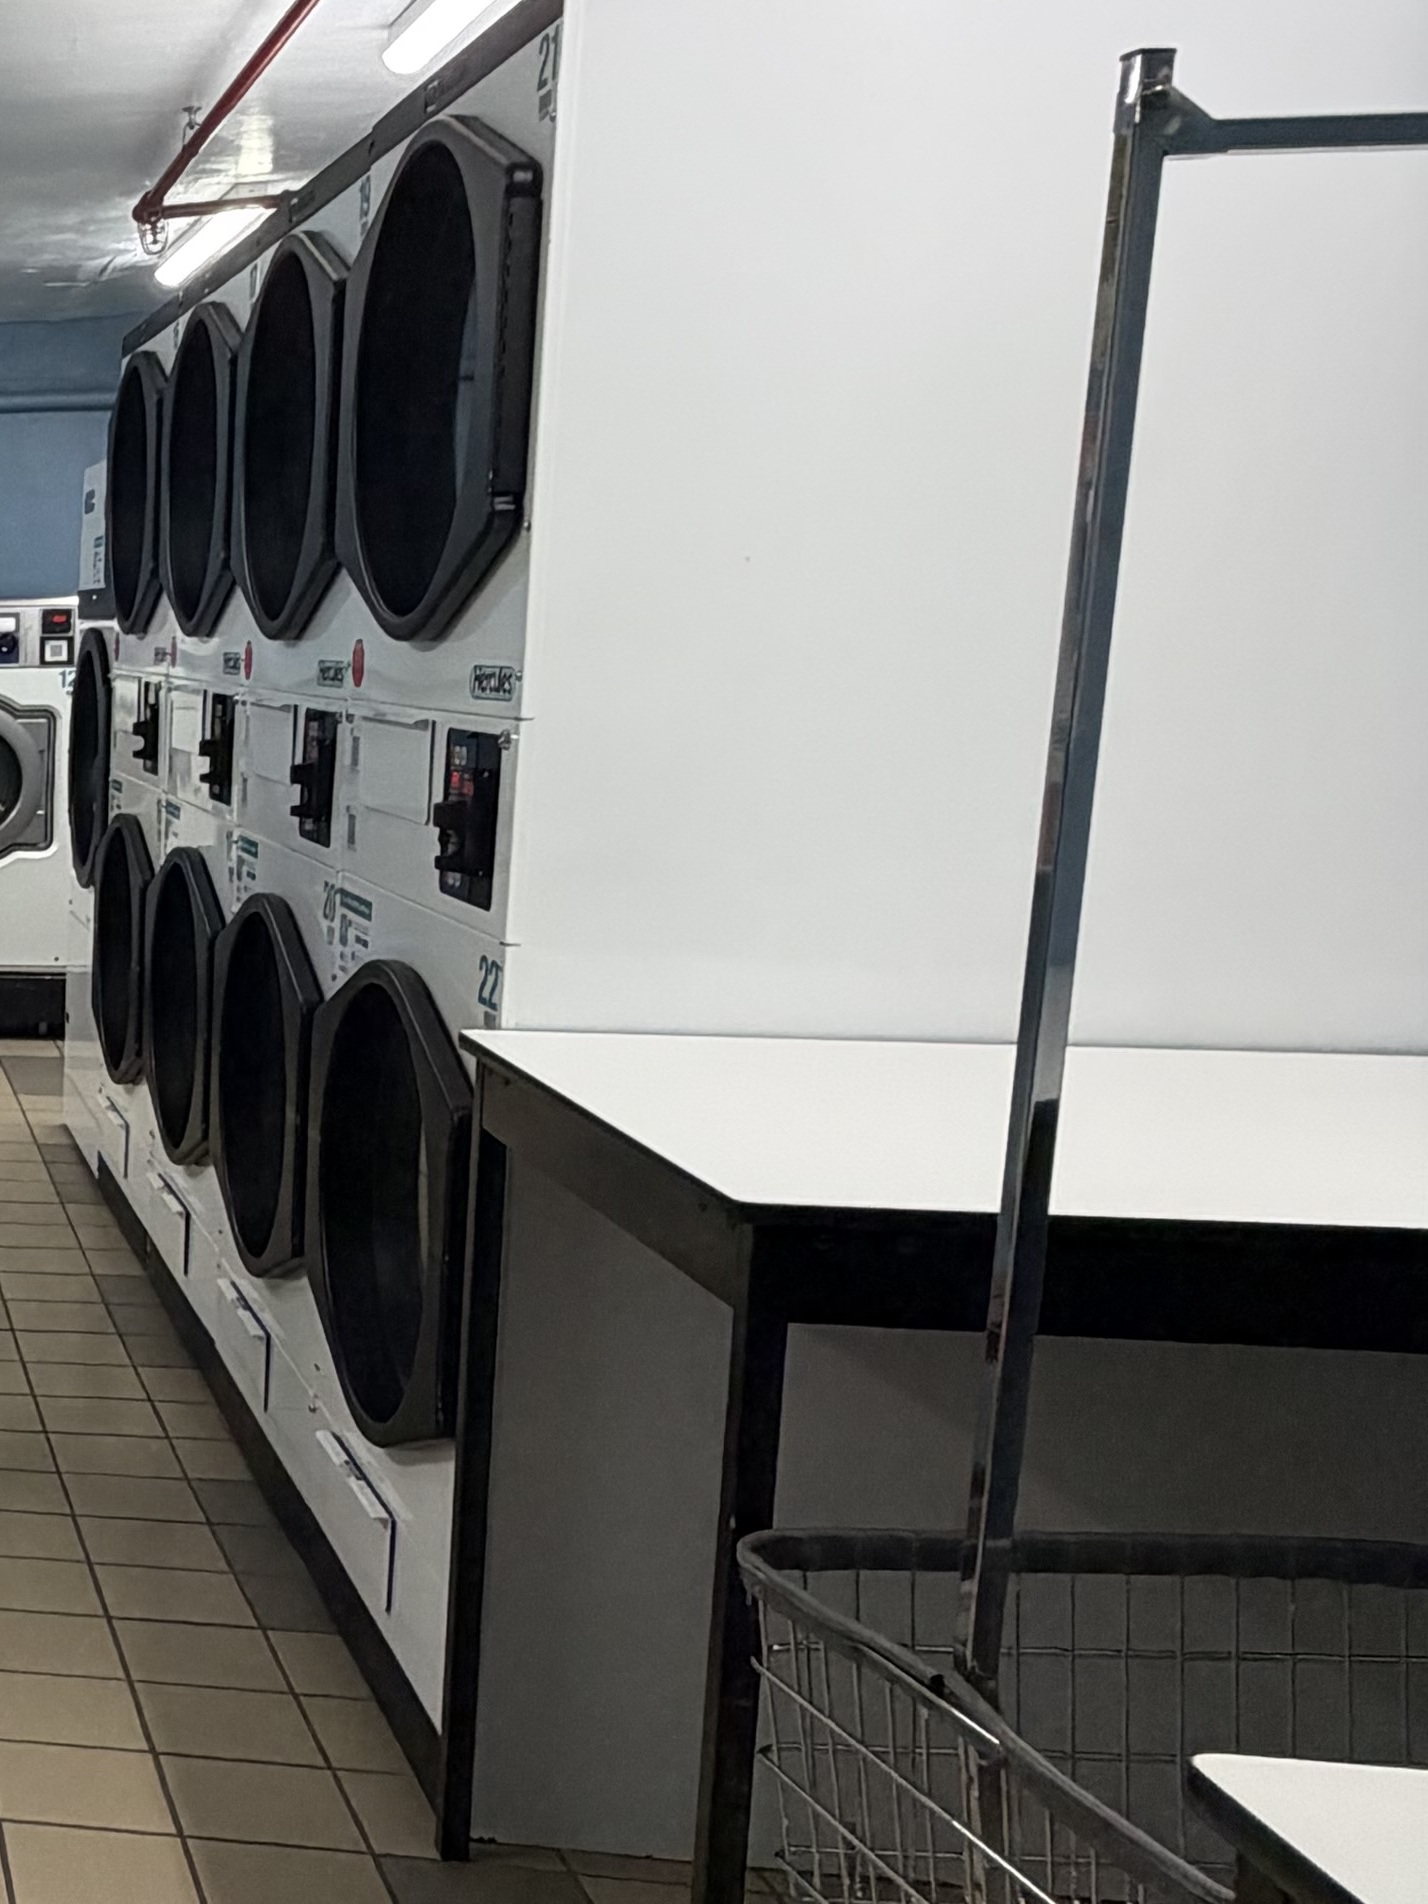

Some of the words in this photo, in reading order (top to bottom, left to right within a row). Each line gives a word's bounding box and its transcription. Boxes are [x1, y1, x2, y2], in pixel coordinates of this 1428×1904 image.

[537, 24, 561, 92] 21
[59, 670, 76, 689] 12
[473, 666, 514, 695] Hercules
[478, 954, 503, 1011] 22
